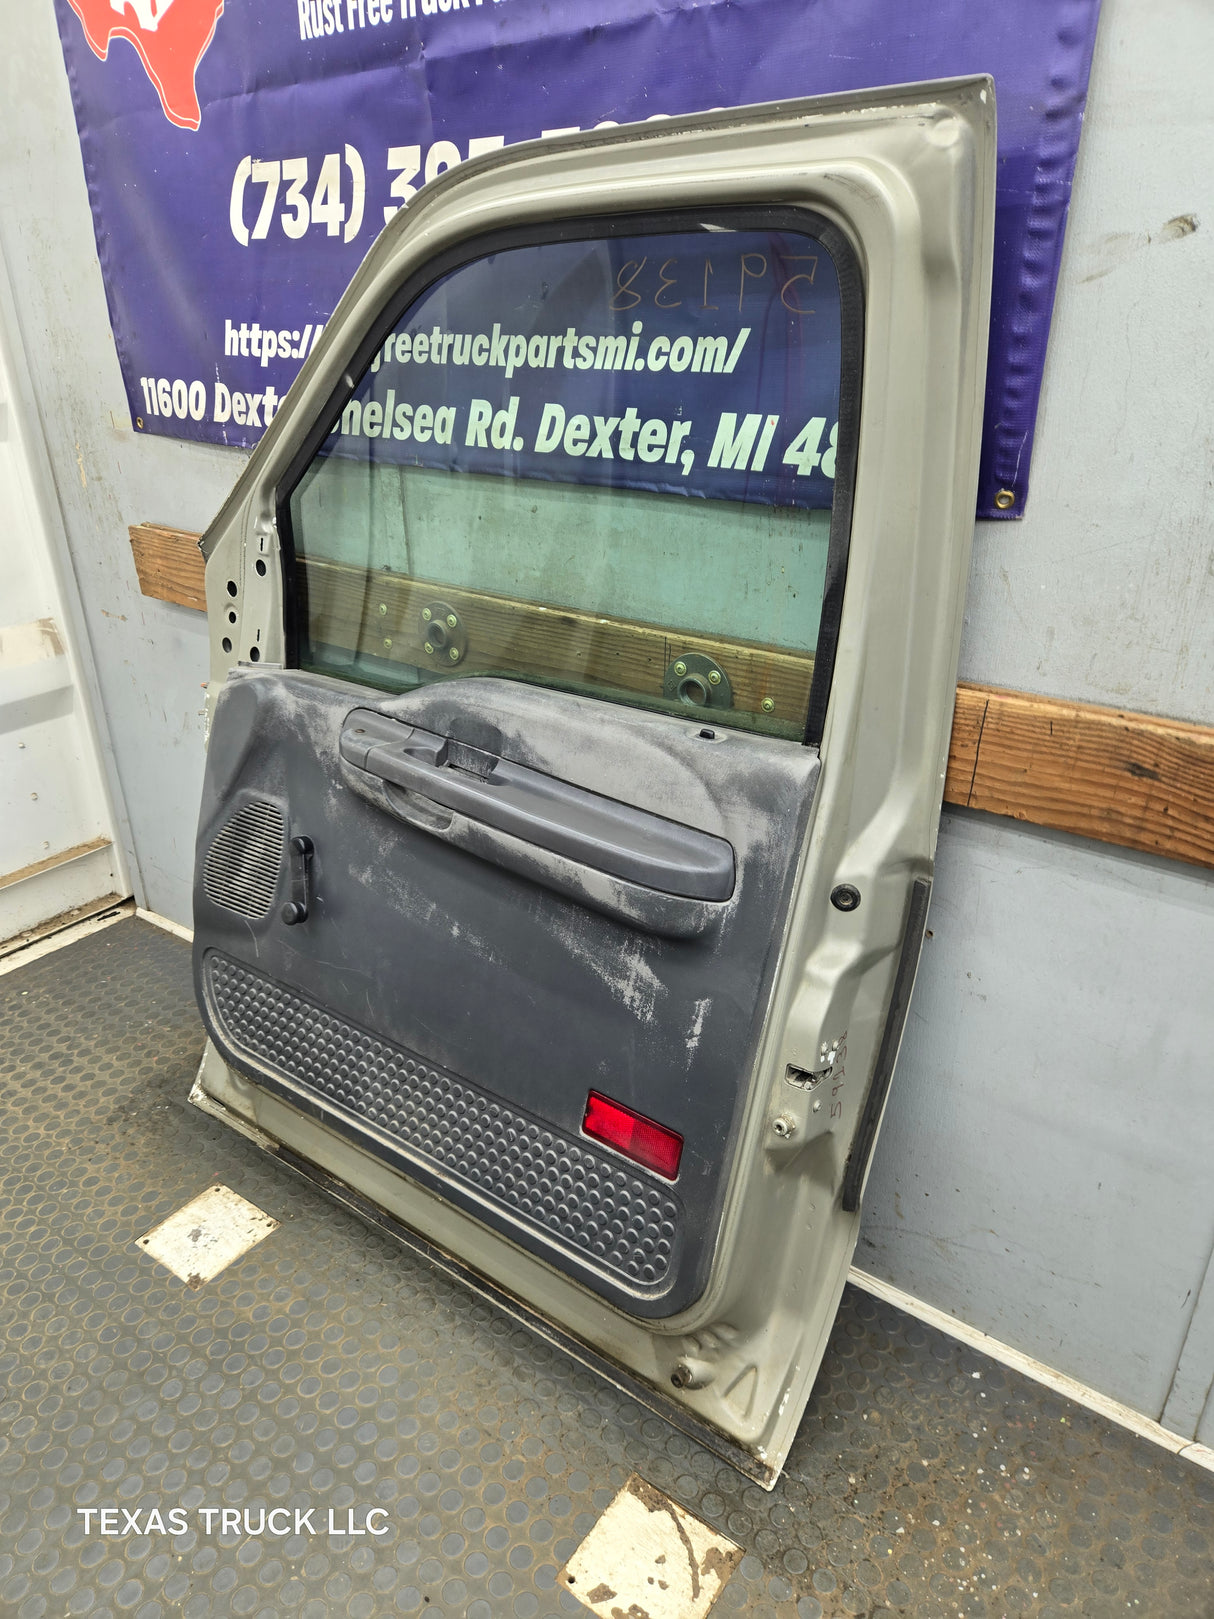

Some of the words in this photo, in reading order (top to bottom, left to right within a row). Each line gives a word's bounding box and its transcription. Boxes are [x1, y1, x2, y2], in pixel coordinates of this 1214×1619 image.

[229, 143, 366, 247] (734)
[140, 377, 206, 421] 11600
[465, 396, 524, 451] Rd.
[534, 402, 696, 476] Dexter,
[707, 412, 780, 472] MI
